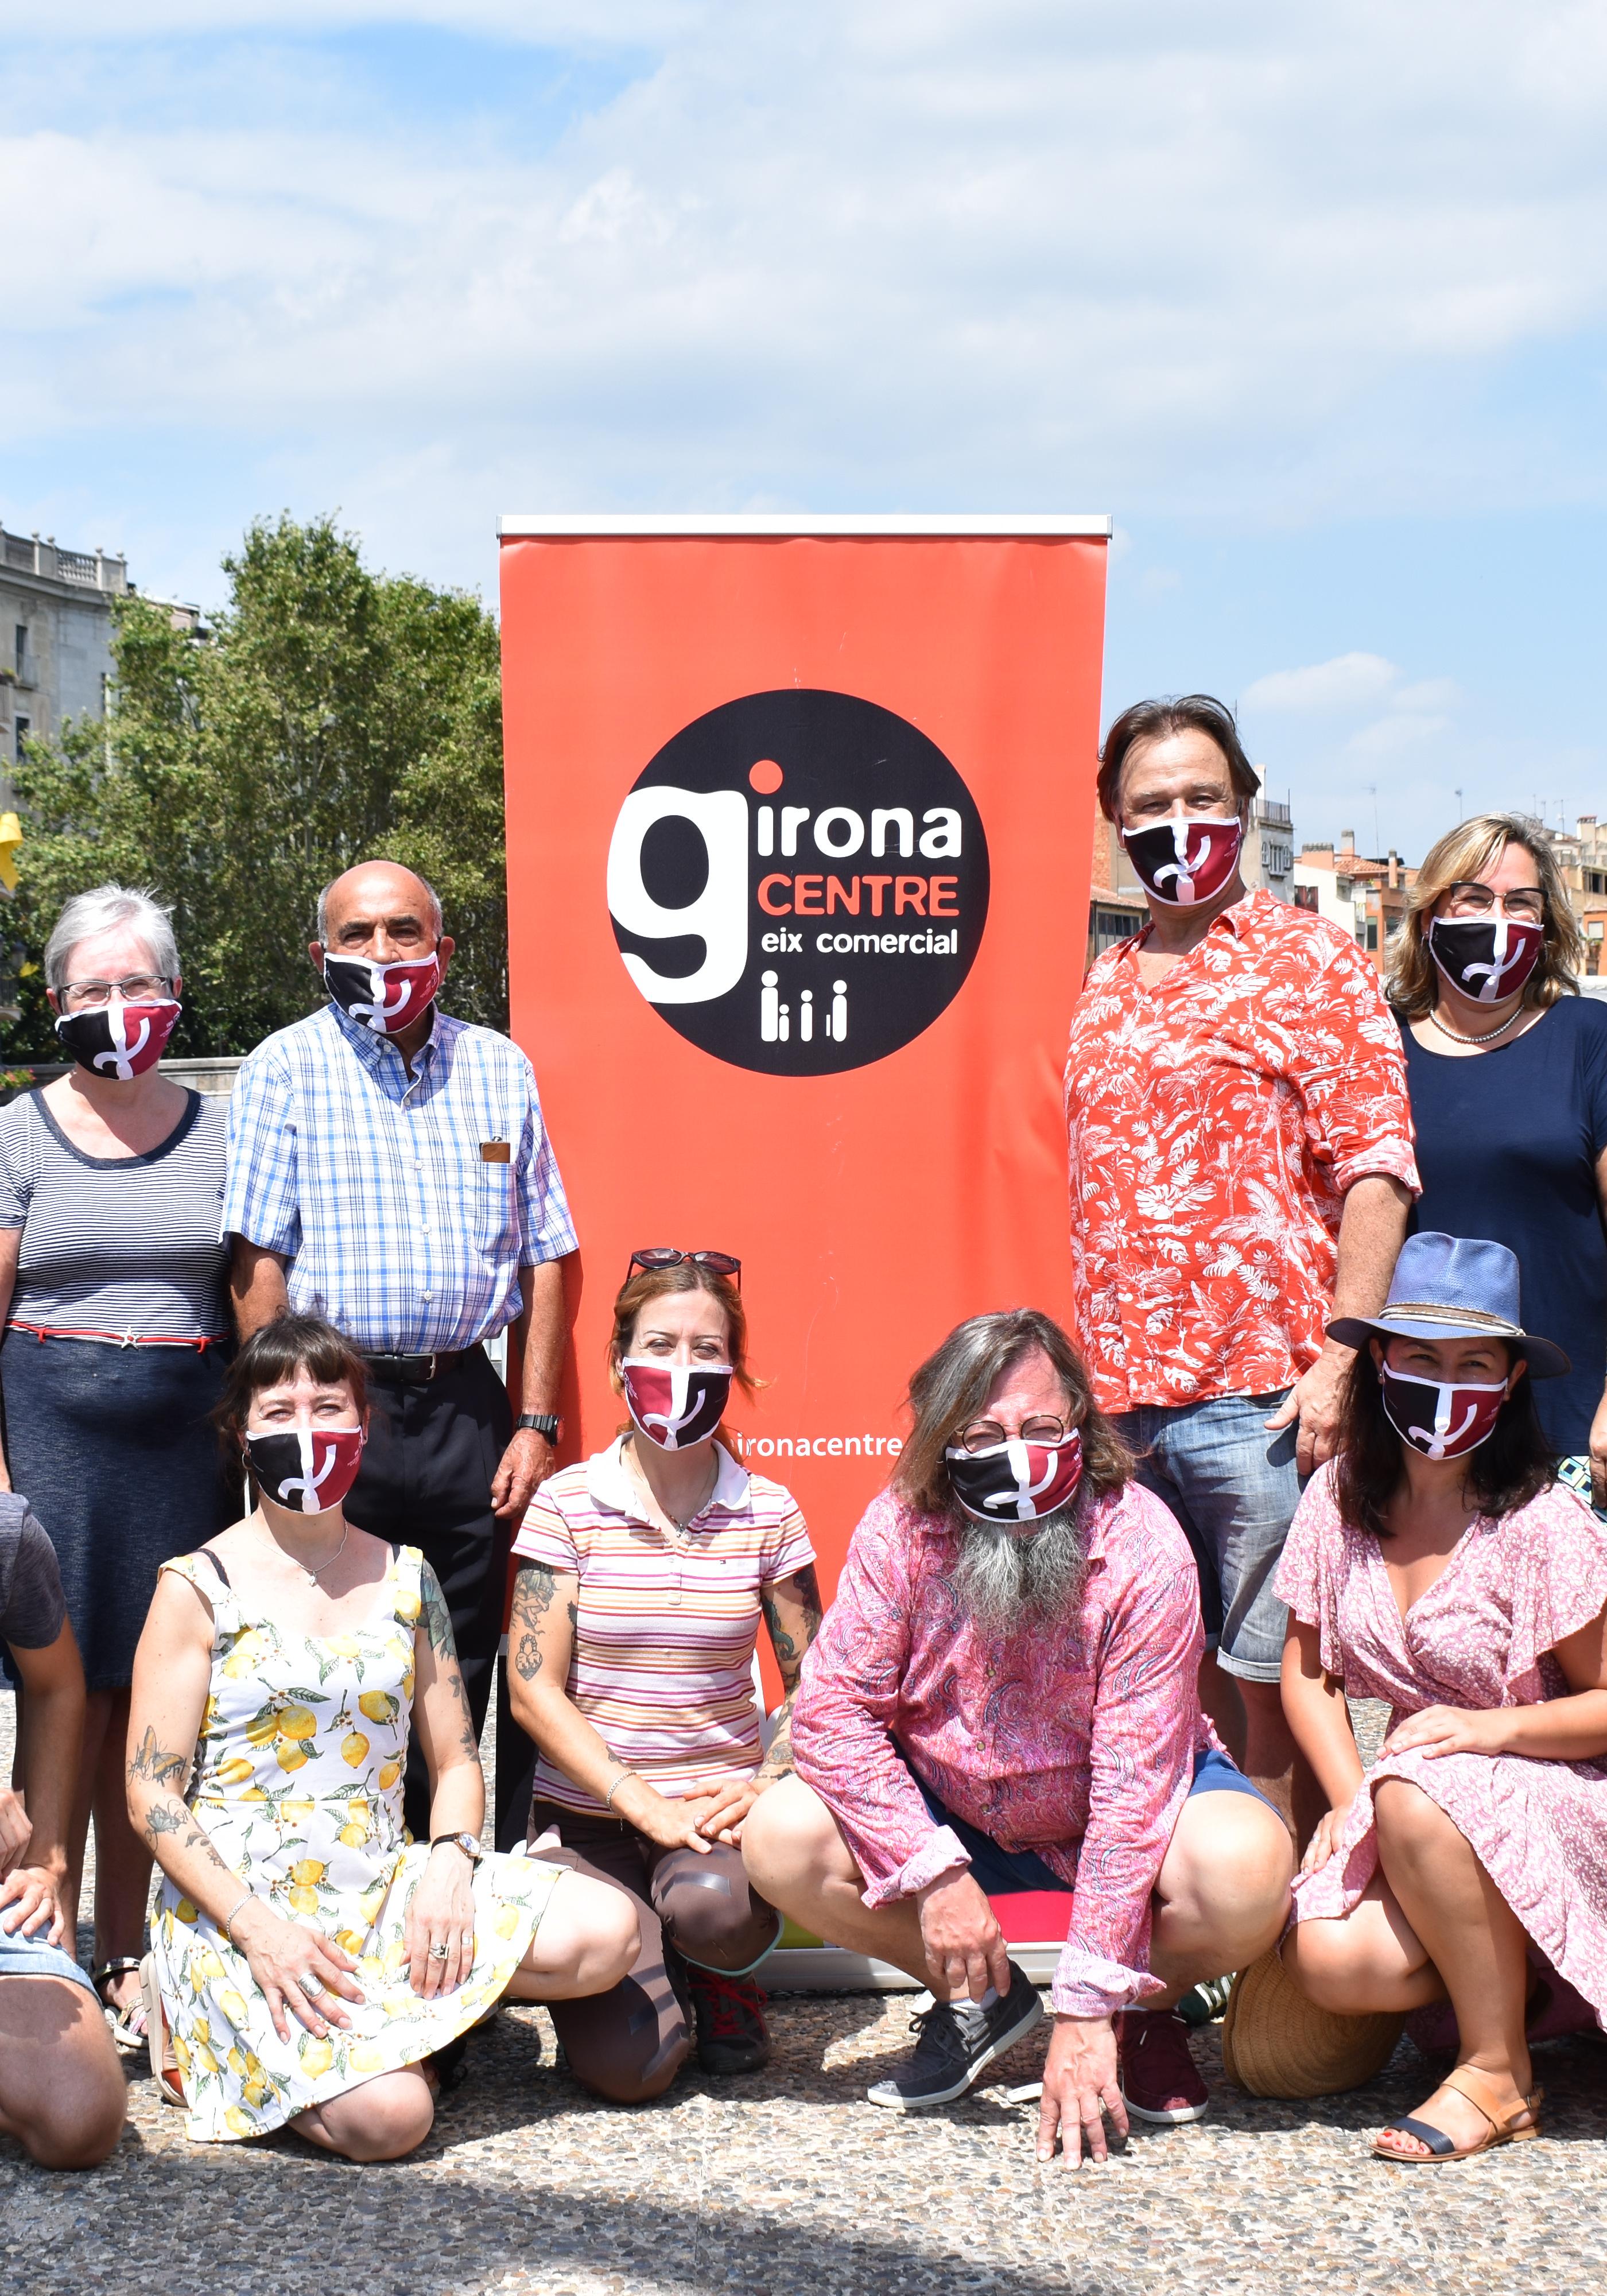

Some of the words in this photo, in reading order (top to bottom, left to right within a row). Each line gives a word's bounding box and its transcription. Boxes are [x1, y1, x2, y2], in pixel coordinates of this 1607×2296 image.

[758, 874, 959, 916] CENTRE
[762, 928, 802, 952] eix
[817, 928, 957, 954] comercial
[730, 1432, 903, 1457] ironacentre
